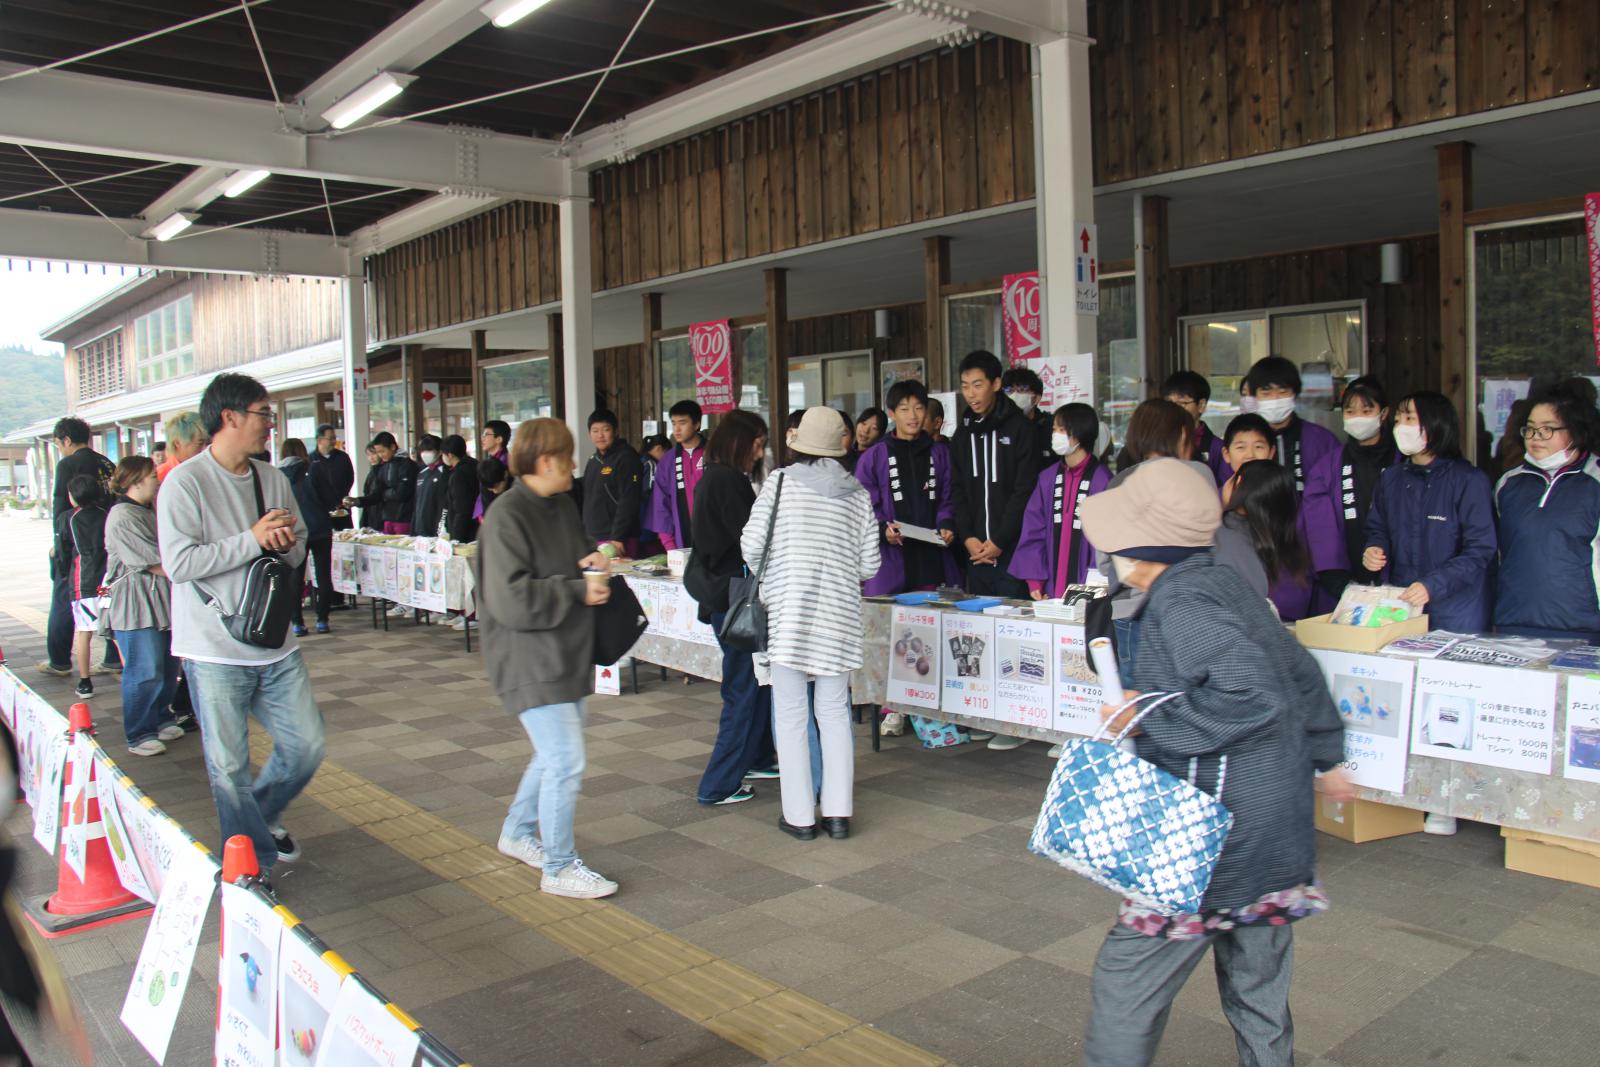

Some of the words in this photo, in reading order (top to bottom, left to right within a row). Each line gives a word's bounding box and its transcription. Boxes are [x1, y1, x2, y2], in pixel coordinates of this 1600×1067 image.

[1077, 288, 1097, 299] トイレ
[1076, 301, 1098, 311] TOILET
[1039, 363, 1070, 388] 食品
[998, 624, 1041, 637] ステッカー
[964, 696, 990, 710] ¥110
[1019, 704, 1048, 720] ¥400
[1476, 732, 1511, 743] トレーナー
[1519, 737, 1548, 750] 1600円
[1487, 744, 1514, 755] Tシャツ
